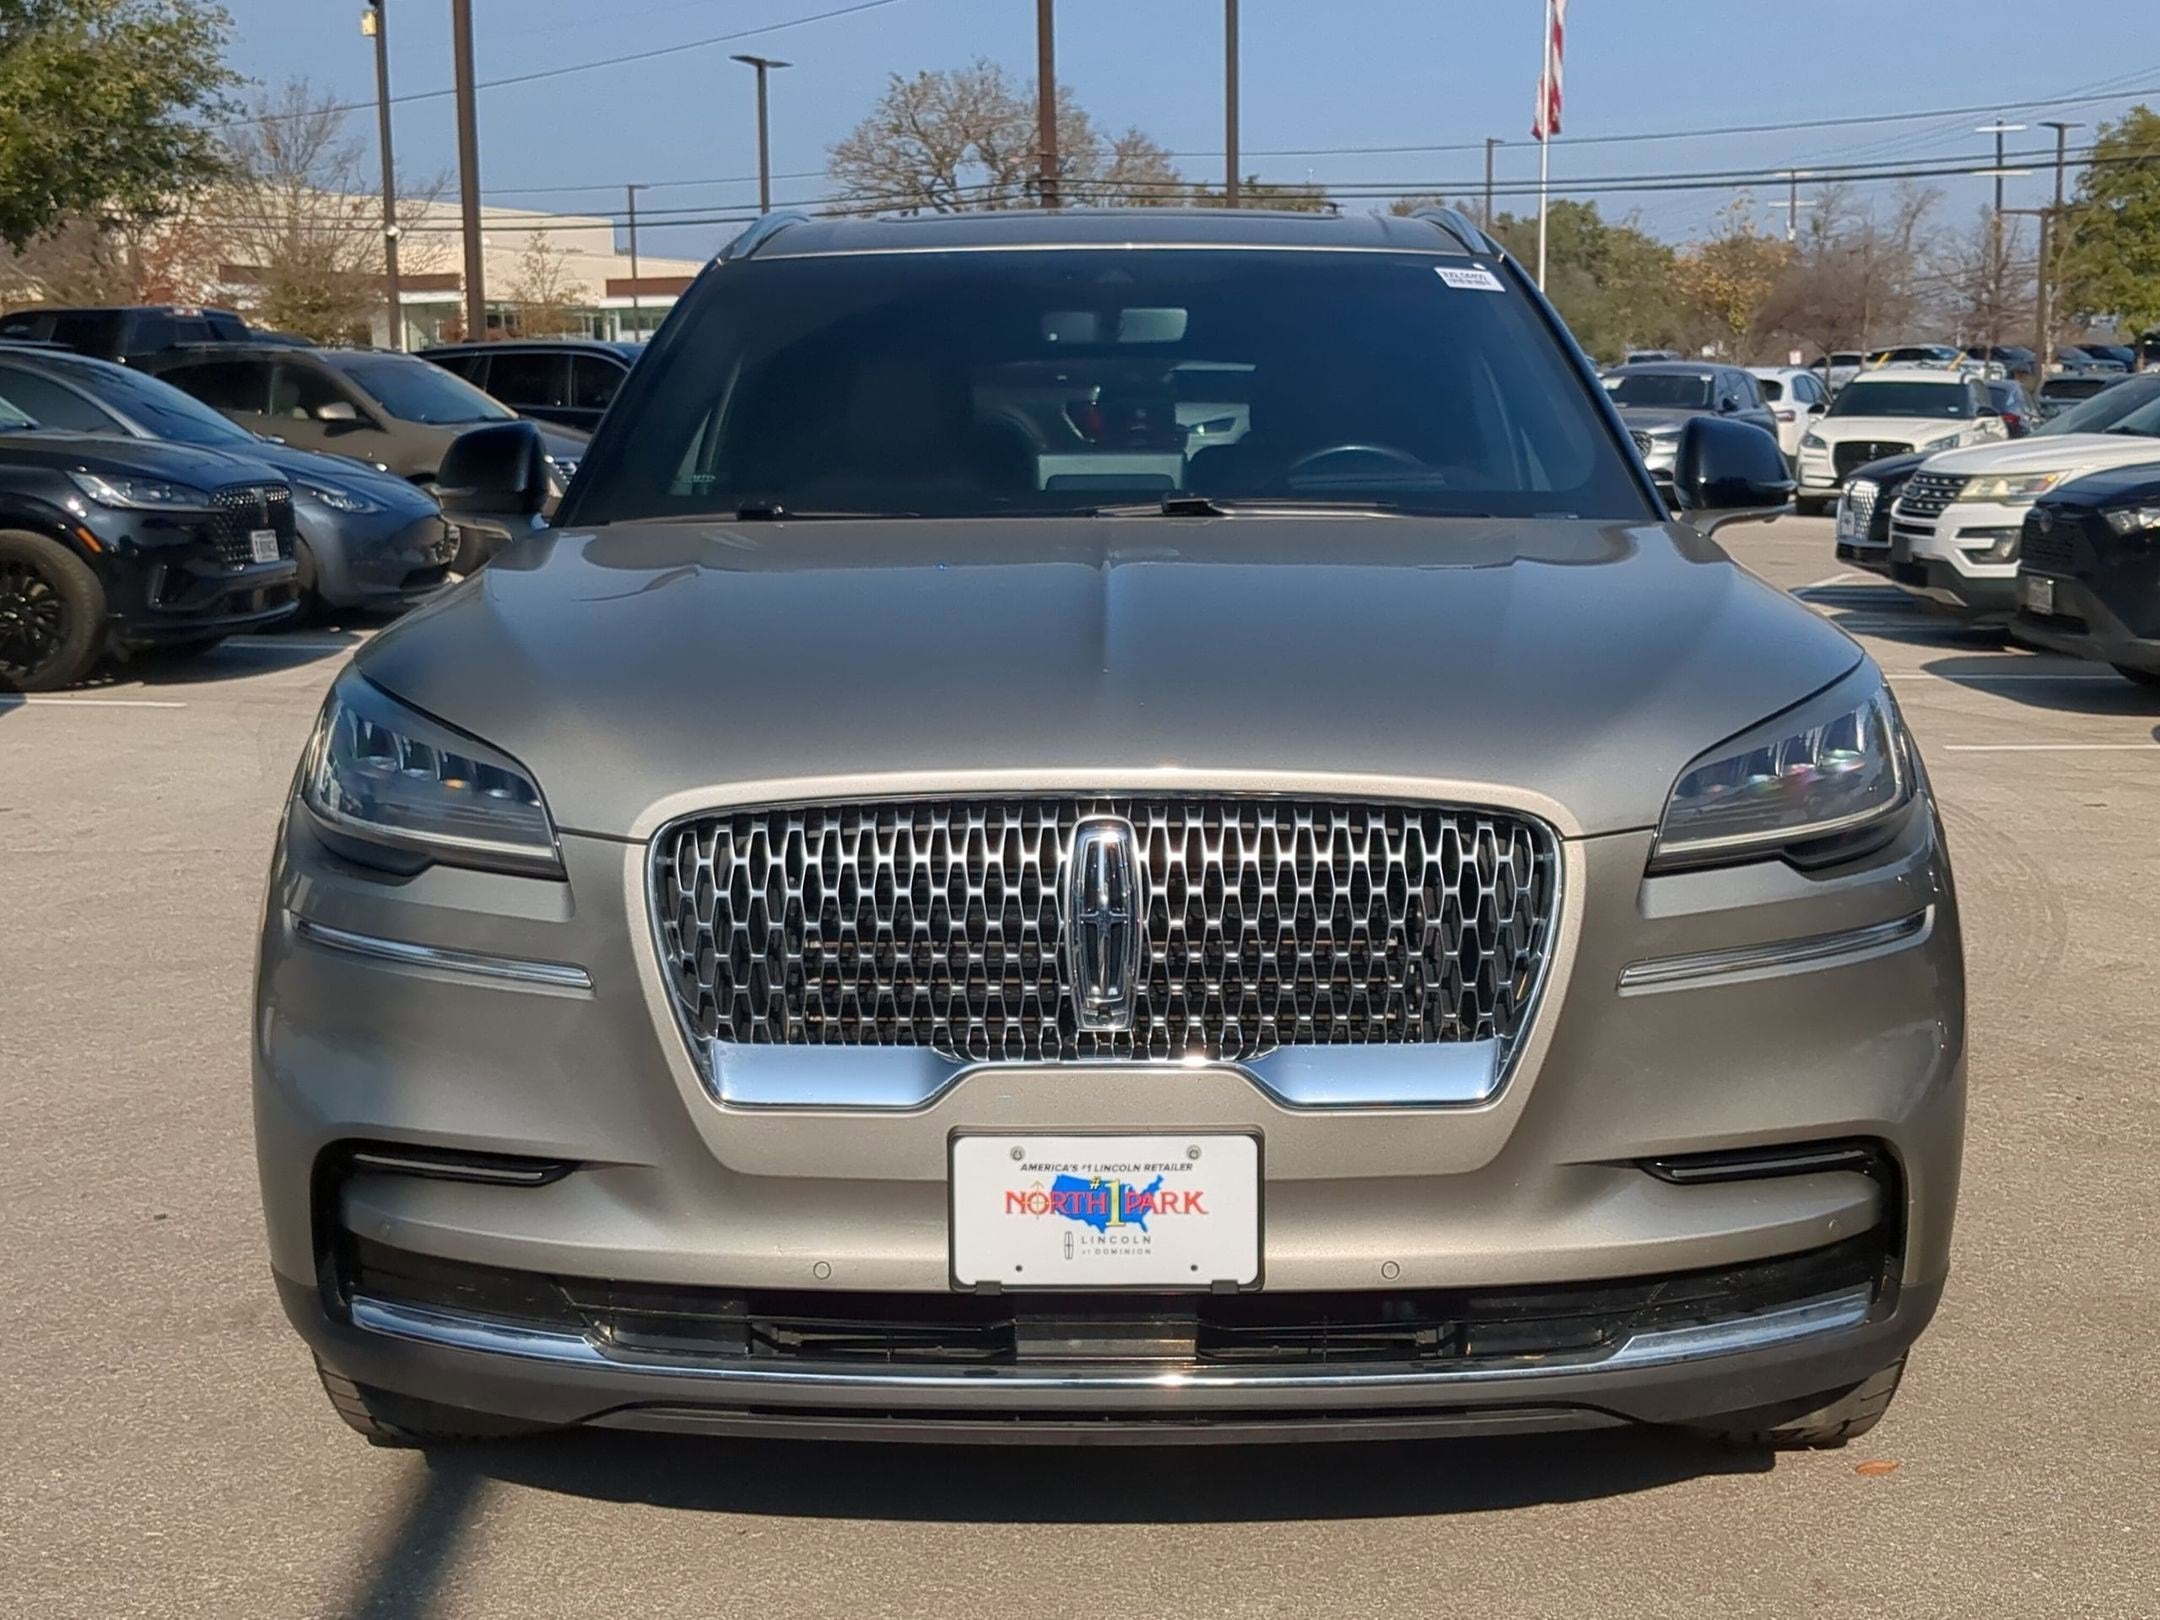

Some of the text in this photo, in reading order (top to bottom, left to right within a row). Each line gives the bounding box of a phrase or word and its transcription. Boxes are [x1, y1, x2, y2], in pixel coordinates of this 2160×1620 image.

[1020, 1163, 1078, 1172] AMERICA'S
[1093, 1164, 1141, 1172] LINCOLN
[1143, 1162, 1193, 1172] RETAILER
[1004, 1190, 1209, 1216] NORTH PARK
[1081, 1236, 1151, 1244] LINCOLN
